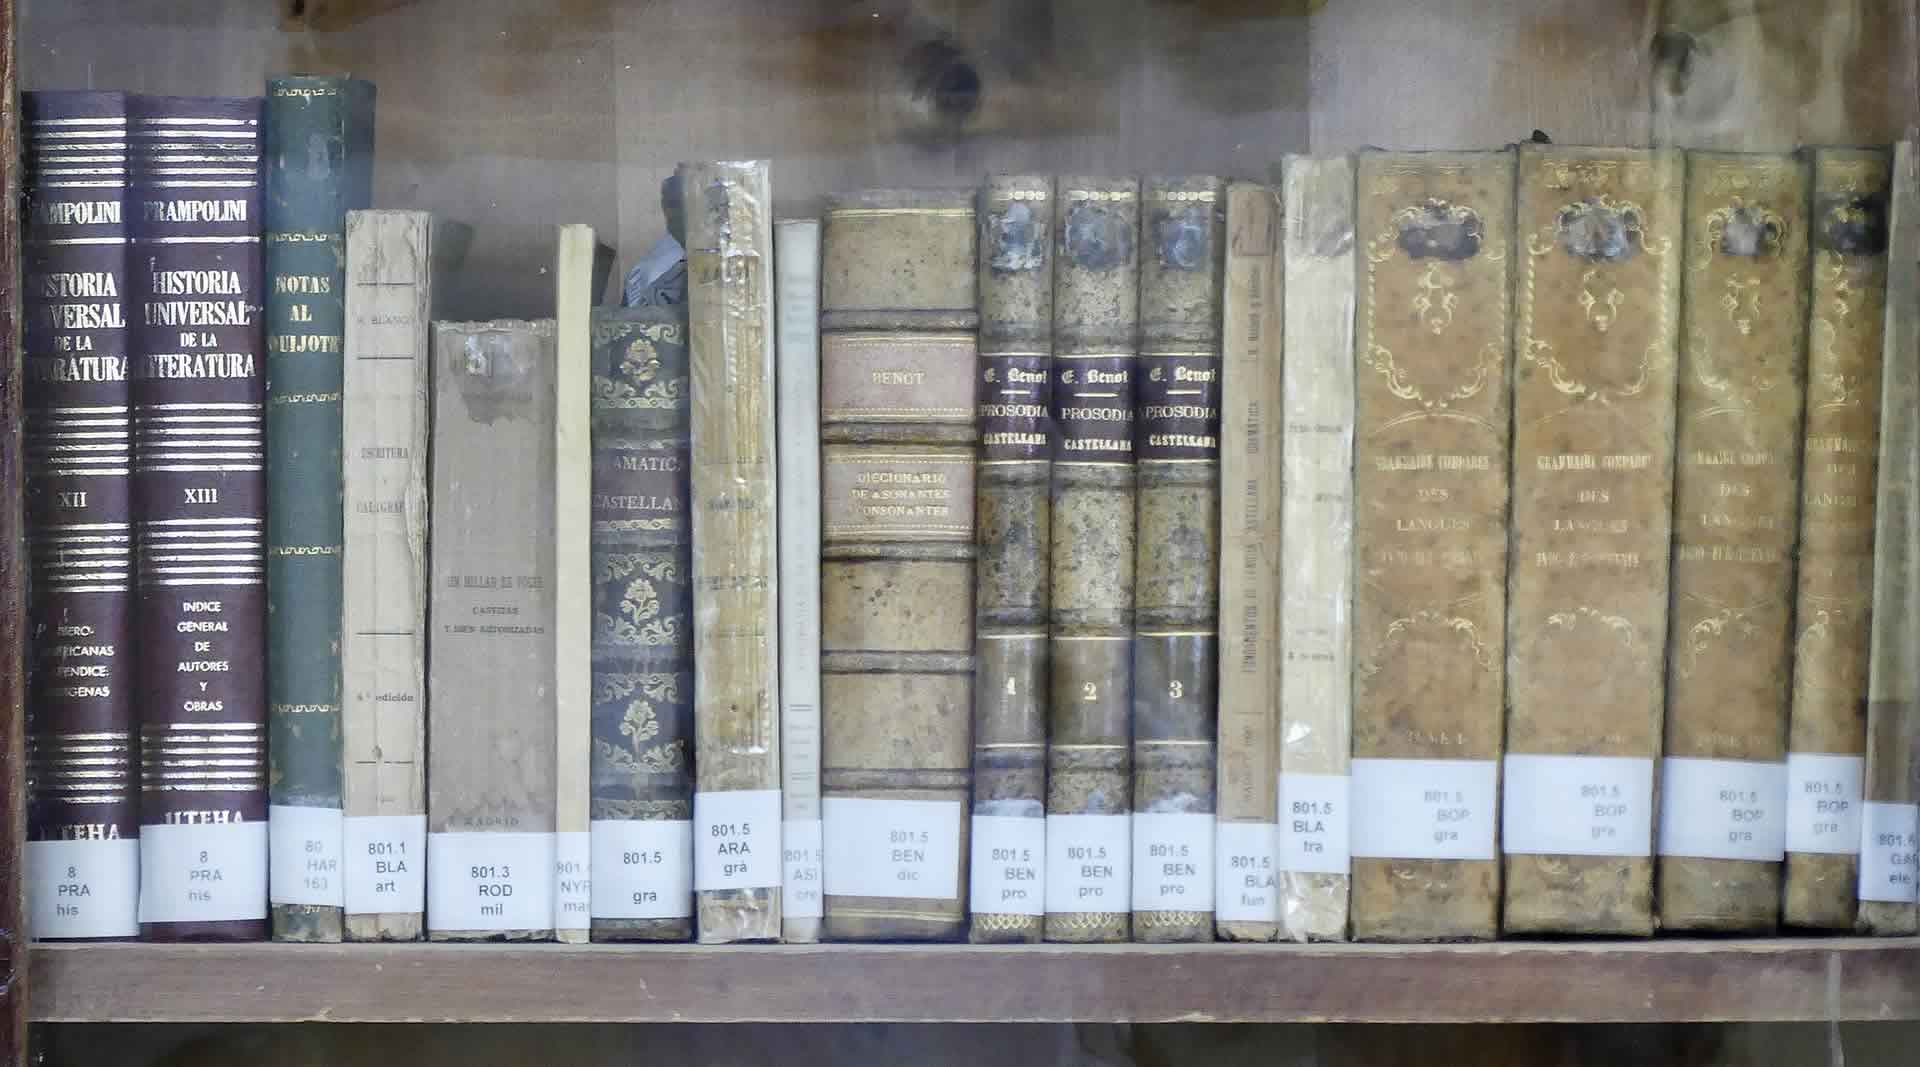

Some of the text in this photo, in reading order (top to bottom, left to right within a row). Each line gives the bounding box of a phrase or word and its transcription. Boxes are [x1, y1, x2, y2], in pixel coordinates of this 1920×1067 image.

[153, 271, 241, 294] HISTORIA
[275, 275, 330, 294] NOTAS
[144, 301, 251, 326] UNIVERSAL
[290, 304, 313, 322] AL
[75, 335, 93, 350] LA
[180, 332, 217, 347] DE LA
[872, 372, 925, 385] BENOT
[980, 404, 1048, 418] PROSODIA
[1061, 407, 1133, 421] PROSODIA
[1145, 405, 1216, 419] PROSODIA
[59, 491, 88, 507] XII
[184, 488, 218, 504] XIII
[182, 602, 222, 612] INDICE
[177, 622, 228, 633] GENERAL
[194, 641, 210, 652] DE
[177, 661, 229, 672] AUTORES
[199, 682, 208, 692] Y
[1006, 677, 1016, 695] 1
[1082, 682, 1097, 700] 2
[1168, 680, 1183, 698] 3
[183, 701, 223, 712] OBRAS
[1292, 801, 1333, 815] 801.5
[1594, 804, 1627, 817] BOP
[1816, 800, 1849, 813] BOP
[711, 823, 751, 837] 801.5
[1293, 820, 1325, 832] BLA
[1813, 822, 1840, 835] gra
[890, 831, 928, 843] 801.5
[1433, 829, 1458, 842] gra
[1728, 830, 1753, 843] gra
[368, 843, 406, 856] 801.1
[718, 842, 751, 855] ARA
[1068, 847, 1107, 859] 801.5
[1149, 844, 1190, 857] 801.5
[1303, 840, 1323, 853] tra
[200, 850, 208, 863] 8
[623, 851, 661, 864] 801.5
[891, 851, 925, 863] BEN
[992, 848, 1031, 861] 801.5
[376, 861, 408, 873] BLA
[1231, 855, 1272, 869] 801.5
[67, 866, 77, 878] 8
[189, 870, 223, 881] PRA
[471, 866, 510, 878] 801.3
[896, 869, 919, 881] dic
[1005, 869, 1036, 880] BEN
[1081, 866, 1113, 878] BEN
[1163, 863, 1196, 876] BEN
[375, 881, 395, 892] art
[1245, 874, 1278, 888] BLA
[58, 884, 91, 897] PRA
[188, 890, 211, 902] his
[479, 884, 513, 897] ROD
[1001, 888, 1027, 900] pro
[1078, 887, 1103, 898] pro
[1160, 885, 1185, 897] pro
[632, 891, 657, 905] gra
[56, 904, 79, 916] his
[480, 903, 503, 916] mil
